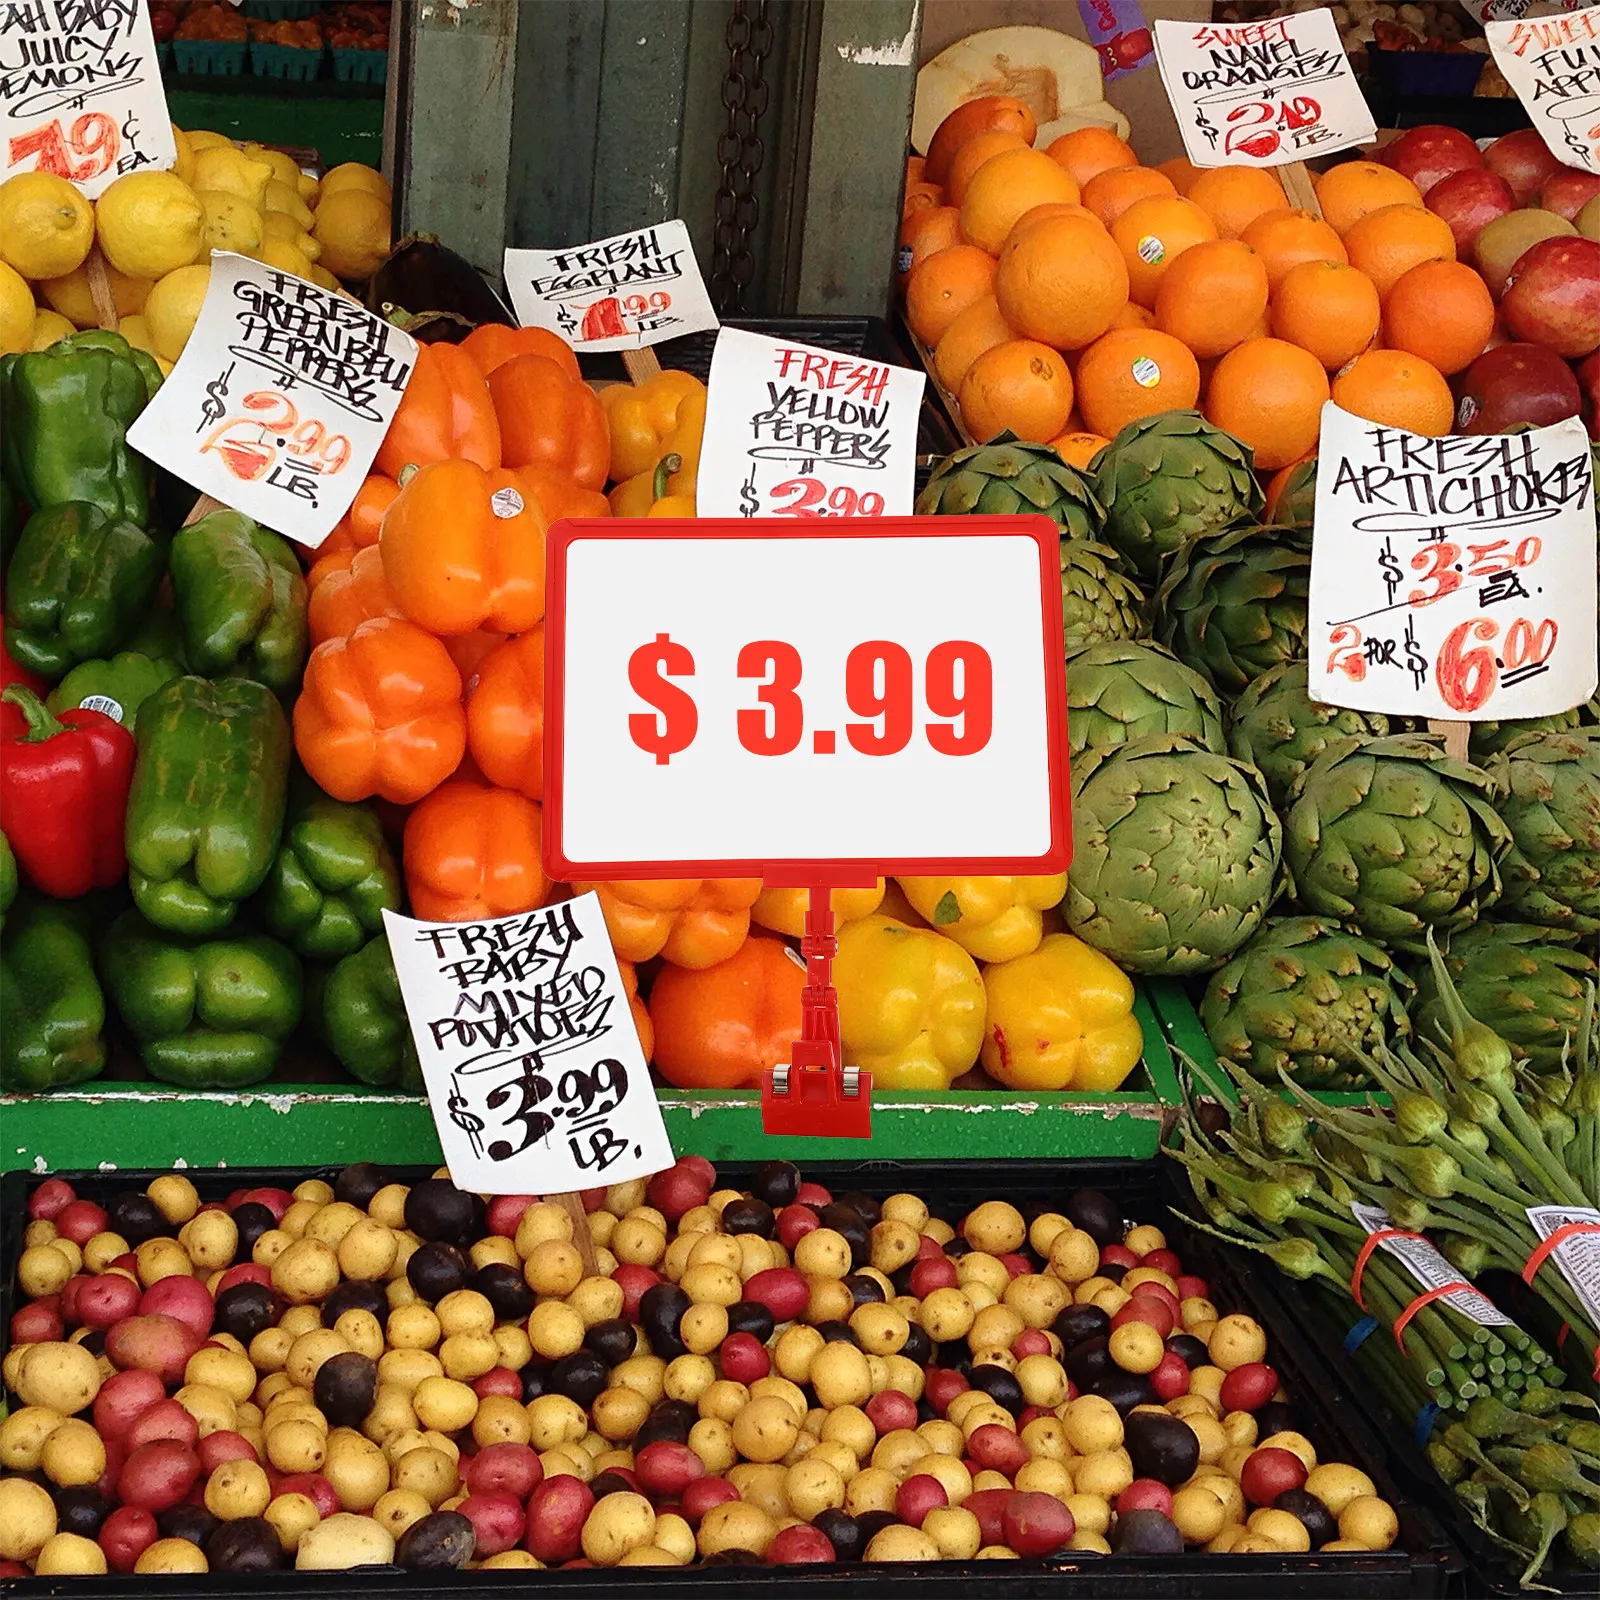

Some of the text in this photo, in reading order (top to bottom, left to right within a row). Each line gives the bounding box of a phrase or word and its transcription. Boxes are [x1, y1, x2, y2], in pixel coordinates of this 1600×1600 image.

[0, 27, 120, 70] JUICY
[1192, 16, 1295, 49] SWEET
[1209, 39, 1317, 69] NAVEL
[0, 51, 144, 99] EMONS
[1182, 50, 1344, 90] ORANGES
[1530, 45, 1600, 77] FU
[1533, 66, 1600, 101] APP
[530, 249, 684, 295] EGGPLANT
[547, 229, 662, 272] FRESH
[233, 281, 342, 356] GREEN
[266, 270, 390, 354] FRESH
[236, 312, 378, 408] PEPPERS
[774, 349, 890, 407] FRESH
[766, 381, 890, 429] YELLOW
[749, 409, 892, 466] PEPPERS
[1364, 428, 1541, 476] FRESH
[266, 466, 319, 509] LB.
[1332, 452, 1592, 519] ARTICHOKES
[1478, 569, 1543, 608] EA.
[1326, 624, 1367, 682] 2
[1363, 637, 1404, 670] FOR
[415, 903, 584, 959] FRESH
[439, 935, 574, 989] BABY
[453, 966, 606, 1018] MIXED
[427, 996, 615, 1050] POTATOES
[568, 1127, 642, 1172] LB.
